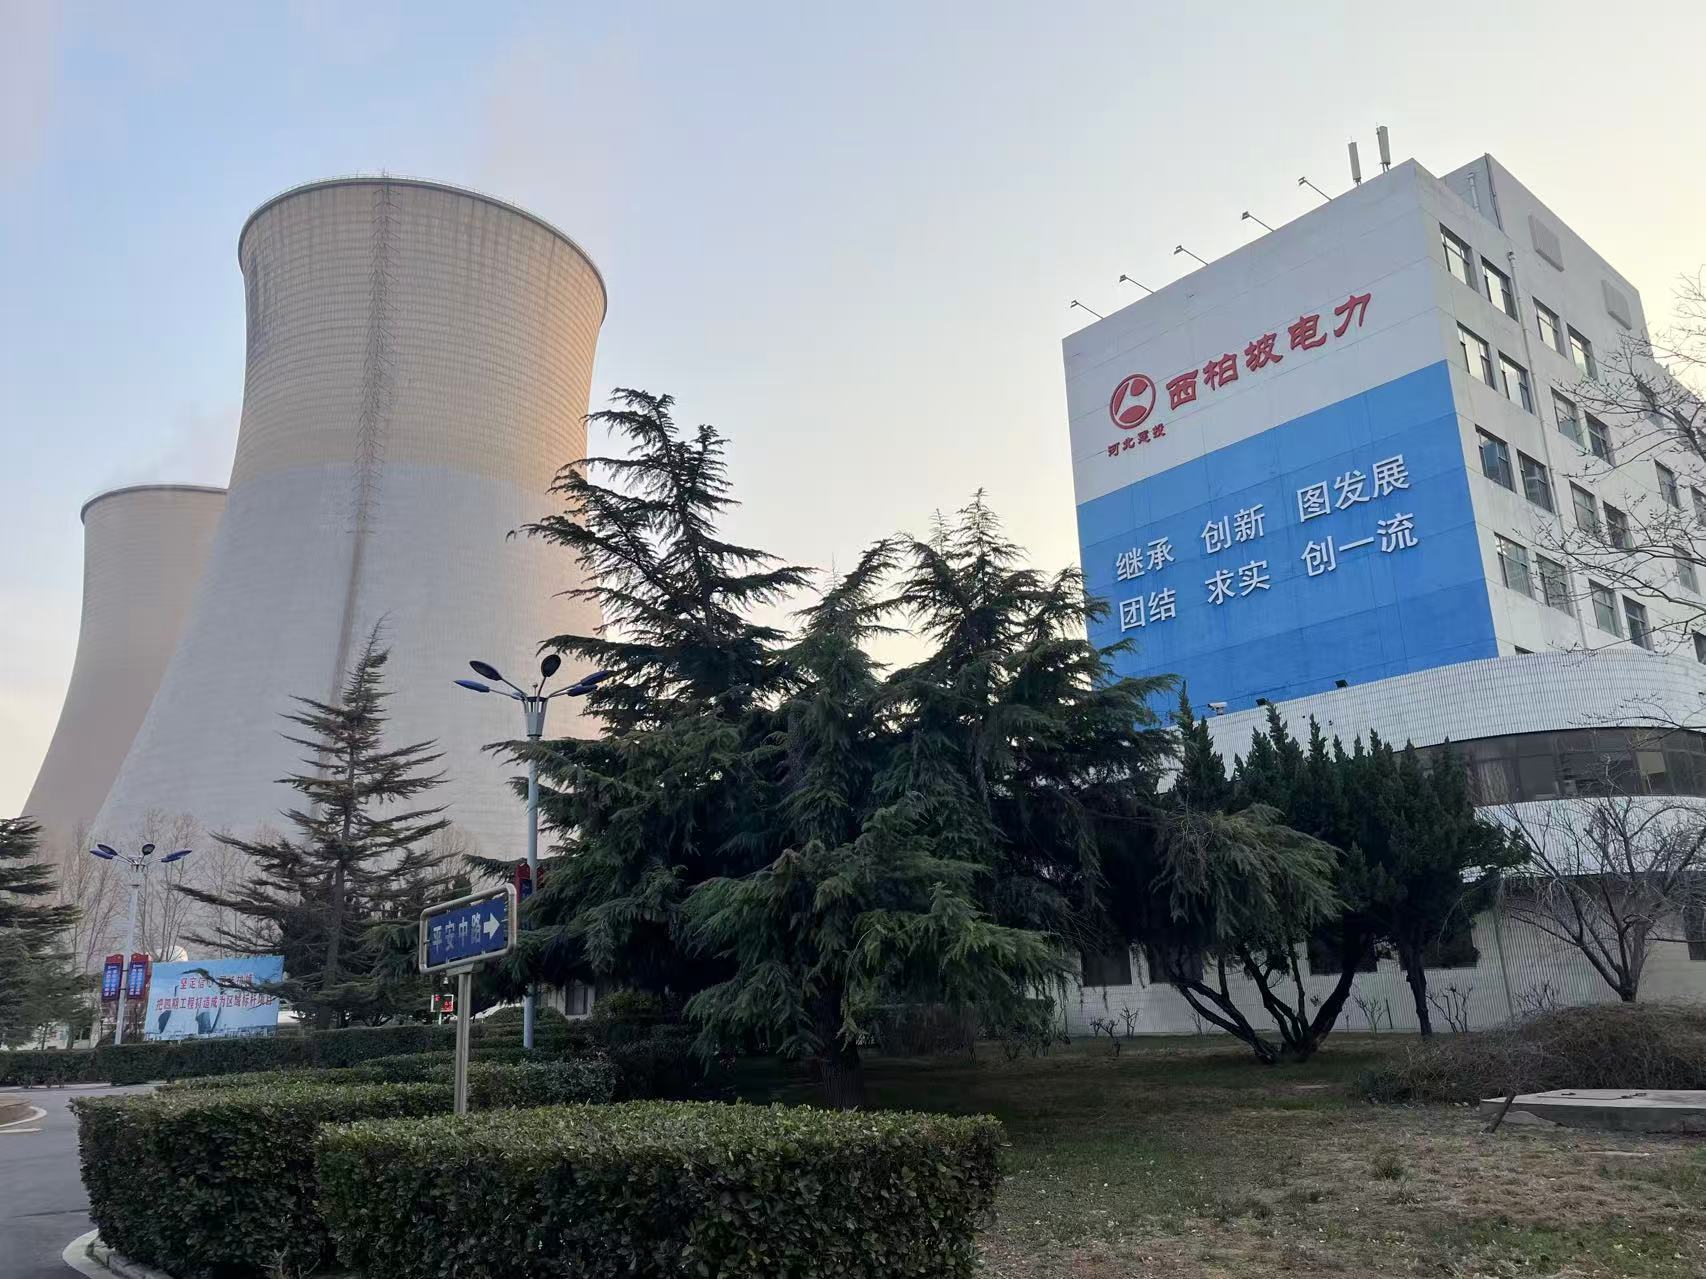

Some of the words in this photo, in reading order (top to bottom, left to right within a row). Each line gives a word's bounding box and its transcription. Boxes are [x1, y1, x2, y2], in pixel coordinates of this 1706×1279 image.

[1166, 293, 1371, 411] 西柏坡电力
[1108, 423, 1166, 457] 河北建投
[1116, 536, 1175, 581] 继承
[1201, 503, 1265, 554] 创新
[1297, 454, 1410, 523] 图发展
[1119, 587, 1177, 633] 团结
[1205, 560, 1271, 605] 求实
[1301, 512, 1418, 577] 创一流
[433, 912, 481, 952] 平安中路
